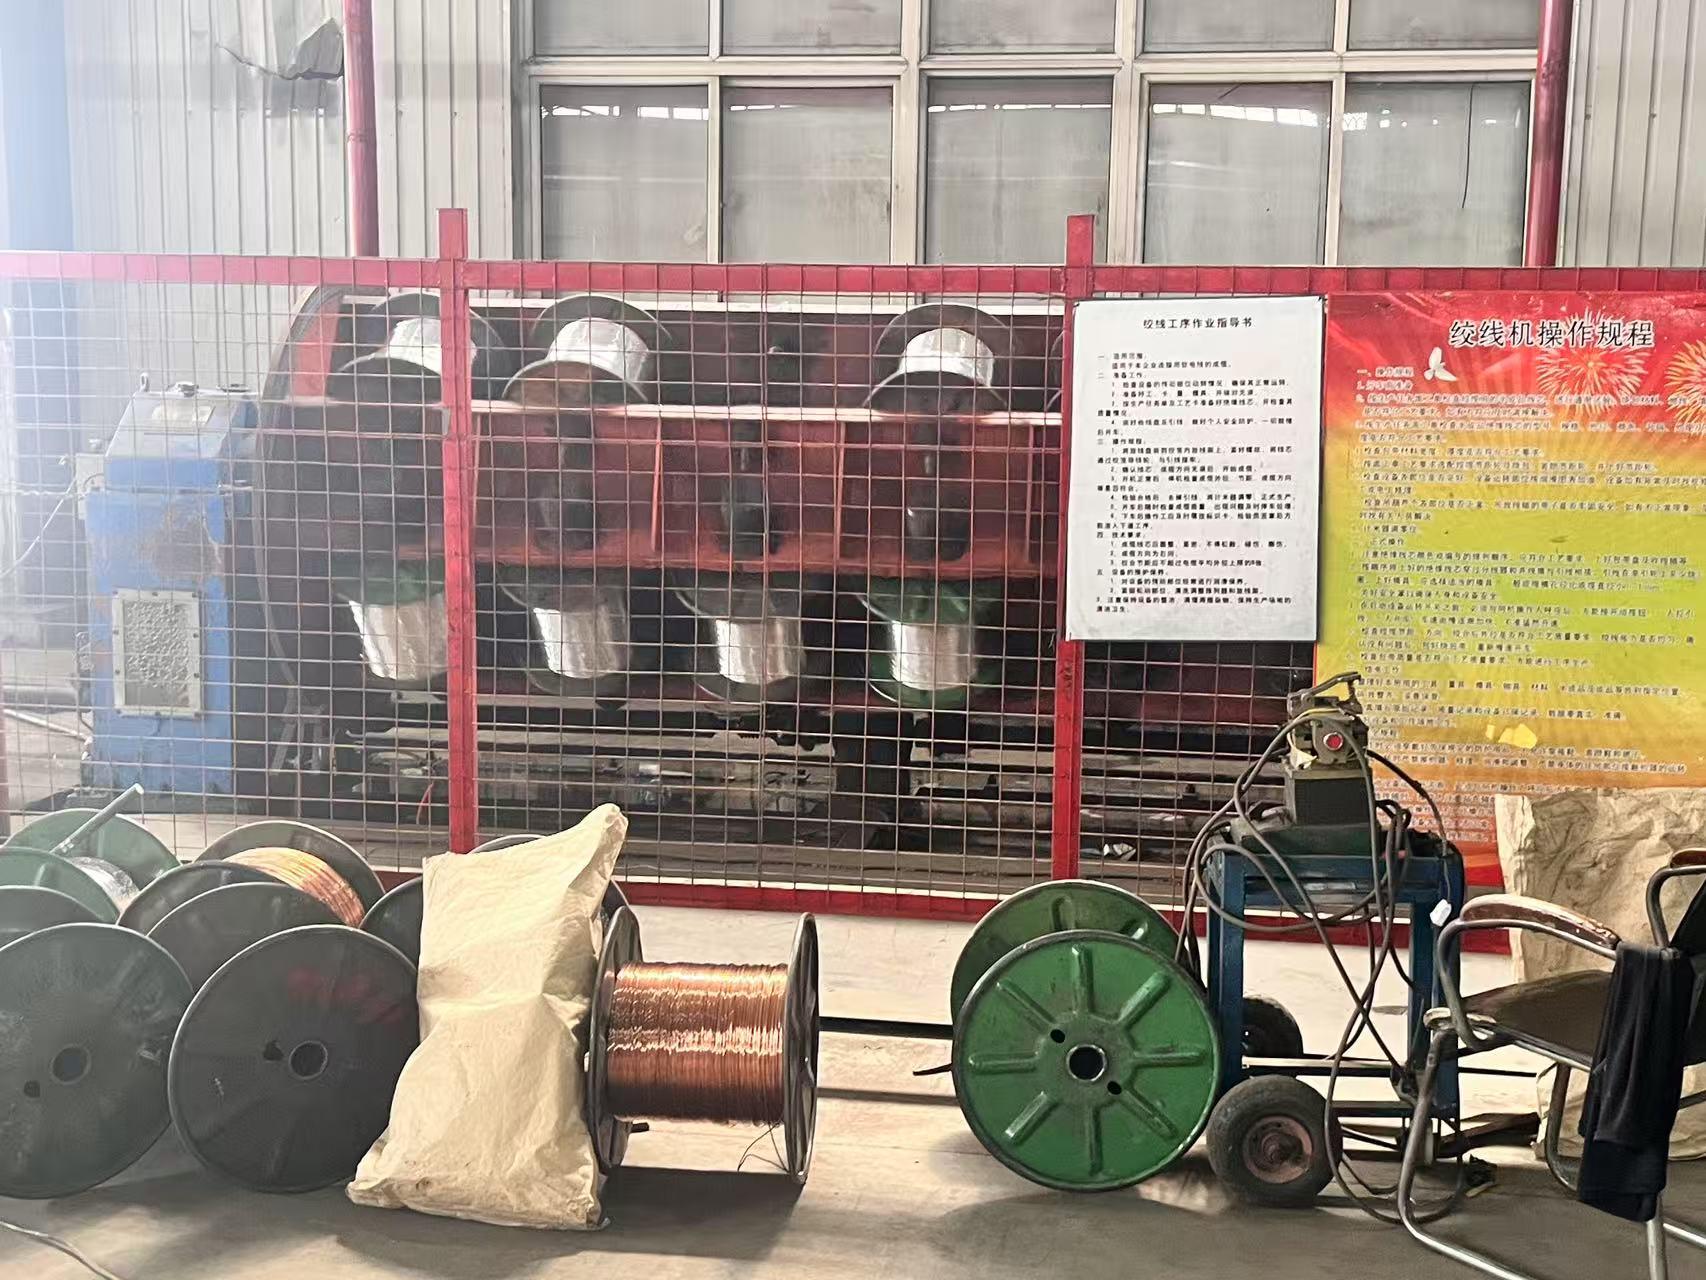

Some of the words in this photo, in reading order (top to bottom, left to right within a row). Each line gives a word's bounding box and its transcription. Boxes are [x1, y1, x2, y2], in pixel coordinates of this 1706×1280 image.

[1143, 317, 1252, 330] 绞线工序作业指导书
[1450, 319, 1655, 348] 绞线机操作规程
